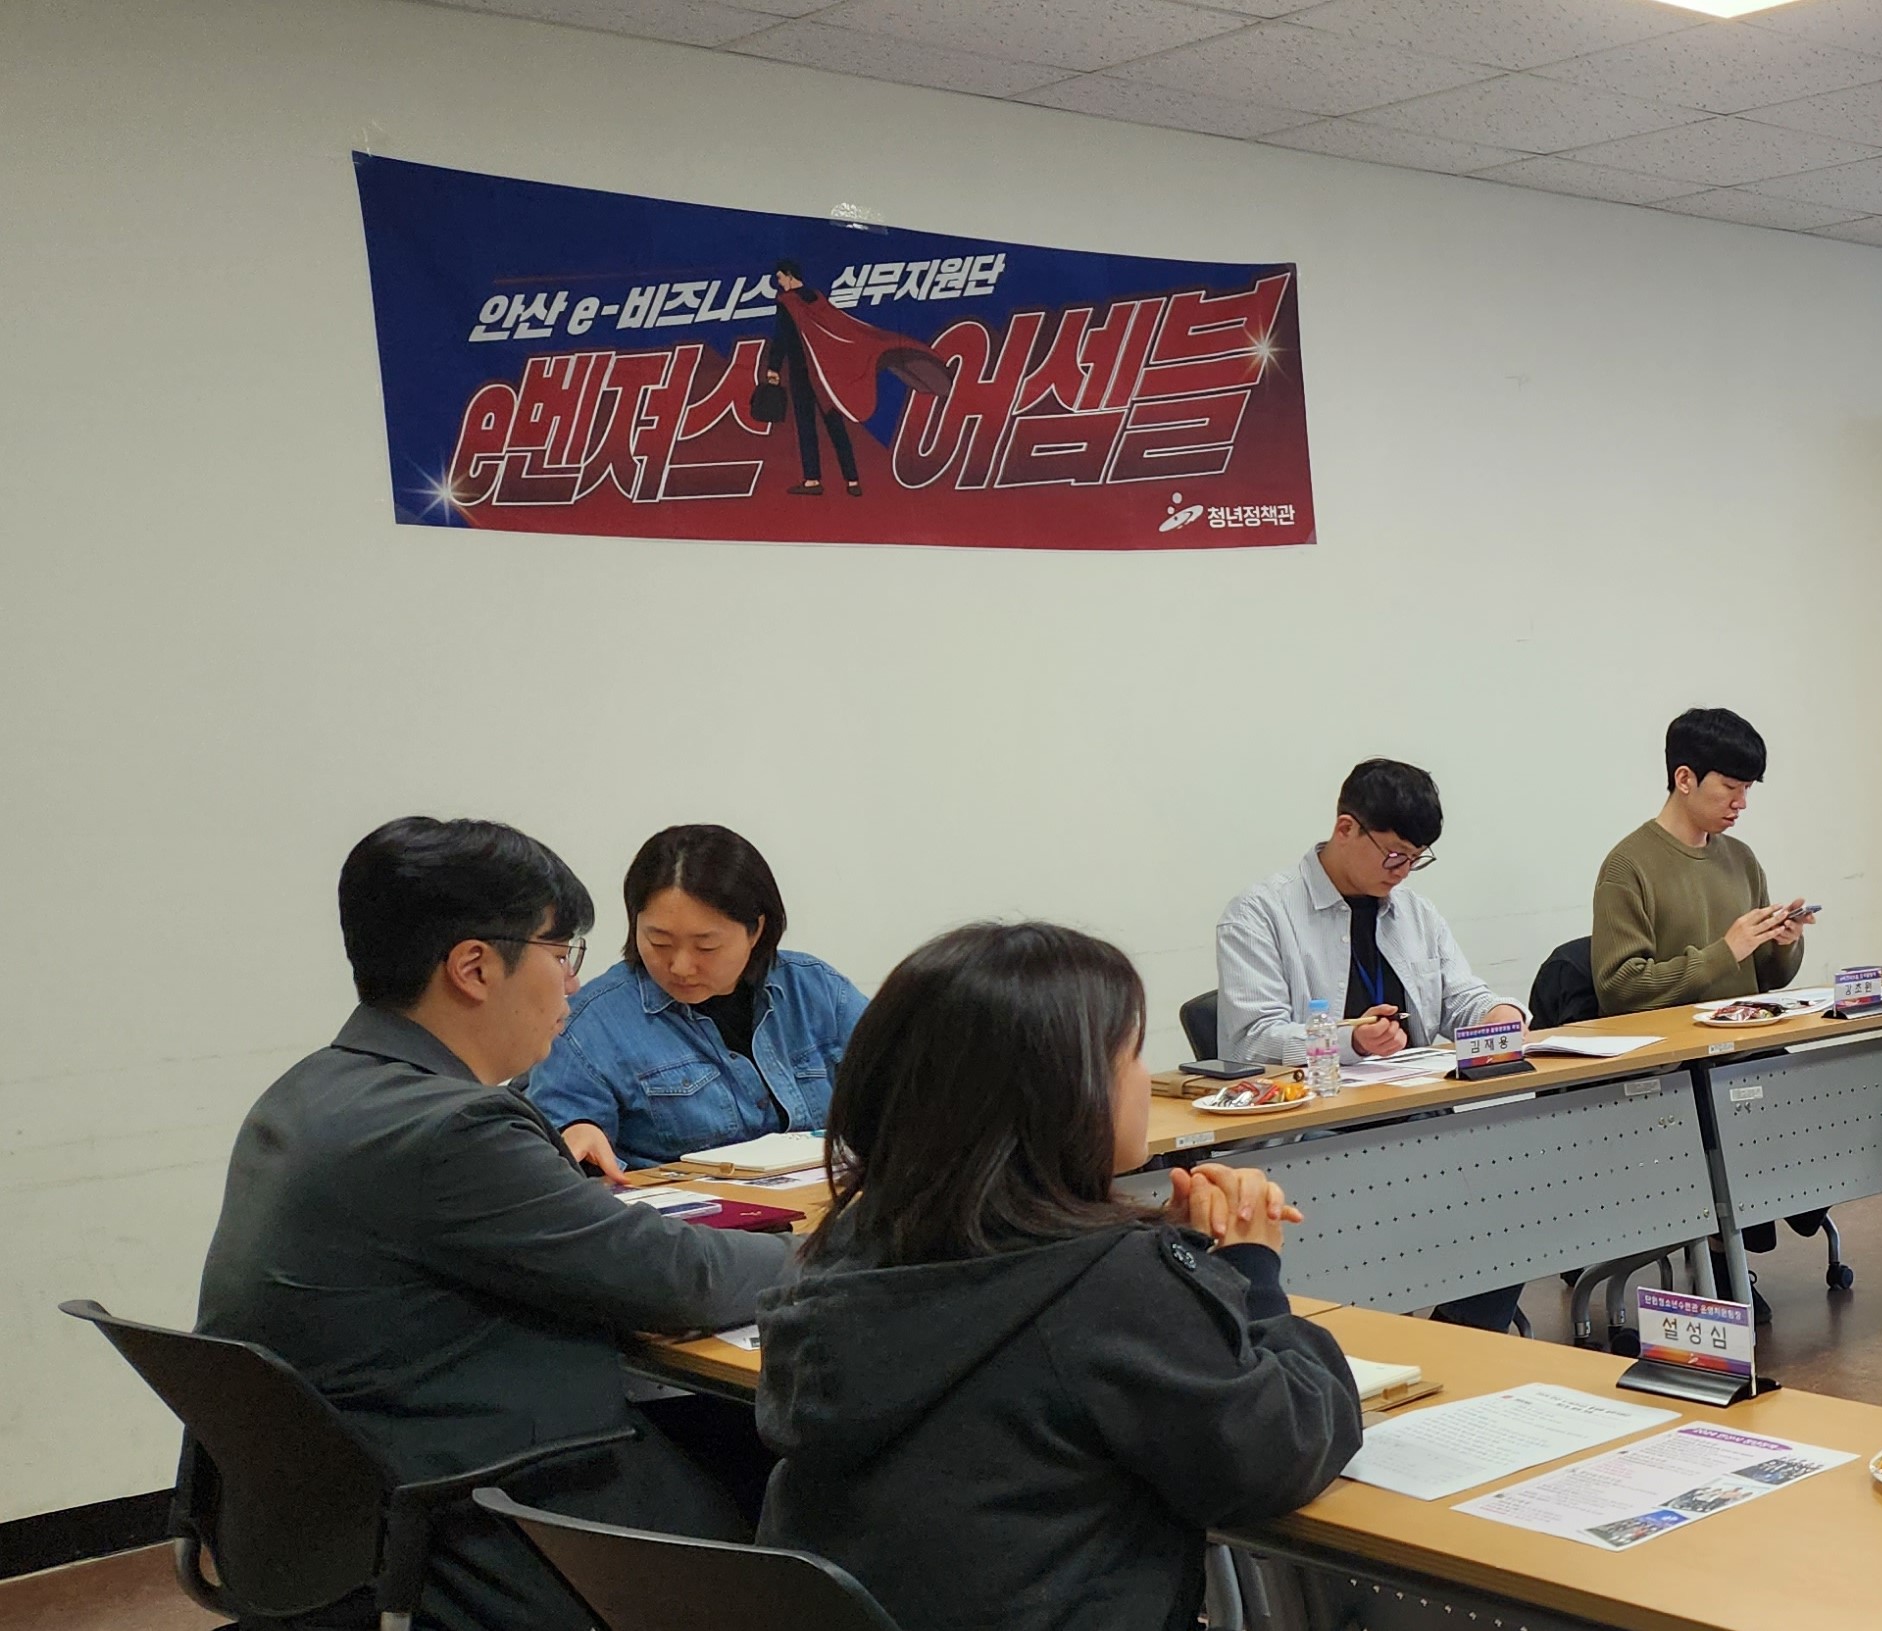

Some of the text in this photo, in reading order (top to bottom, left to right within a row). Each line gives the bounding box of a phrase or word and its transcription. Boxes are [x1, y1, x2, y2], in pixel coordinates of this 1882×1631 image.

[468, 253, 1006, 342] 안산 e-비즈니스 실무지원단
[448, 273, 1291, 506] e벤져스 어셈블
[1207, 505, 1296, 528] 청년정책관
